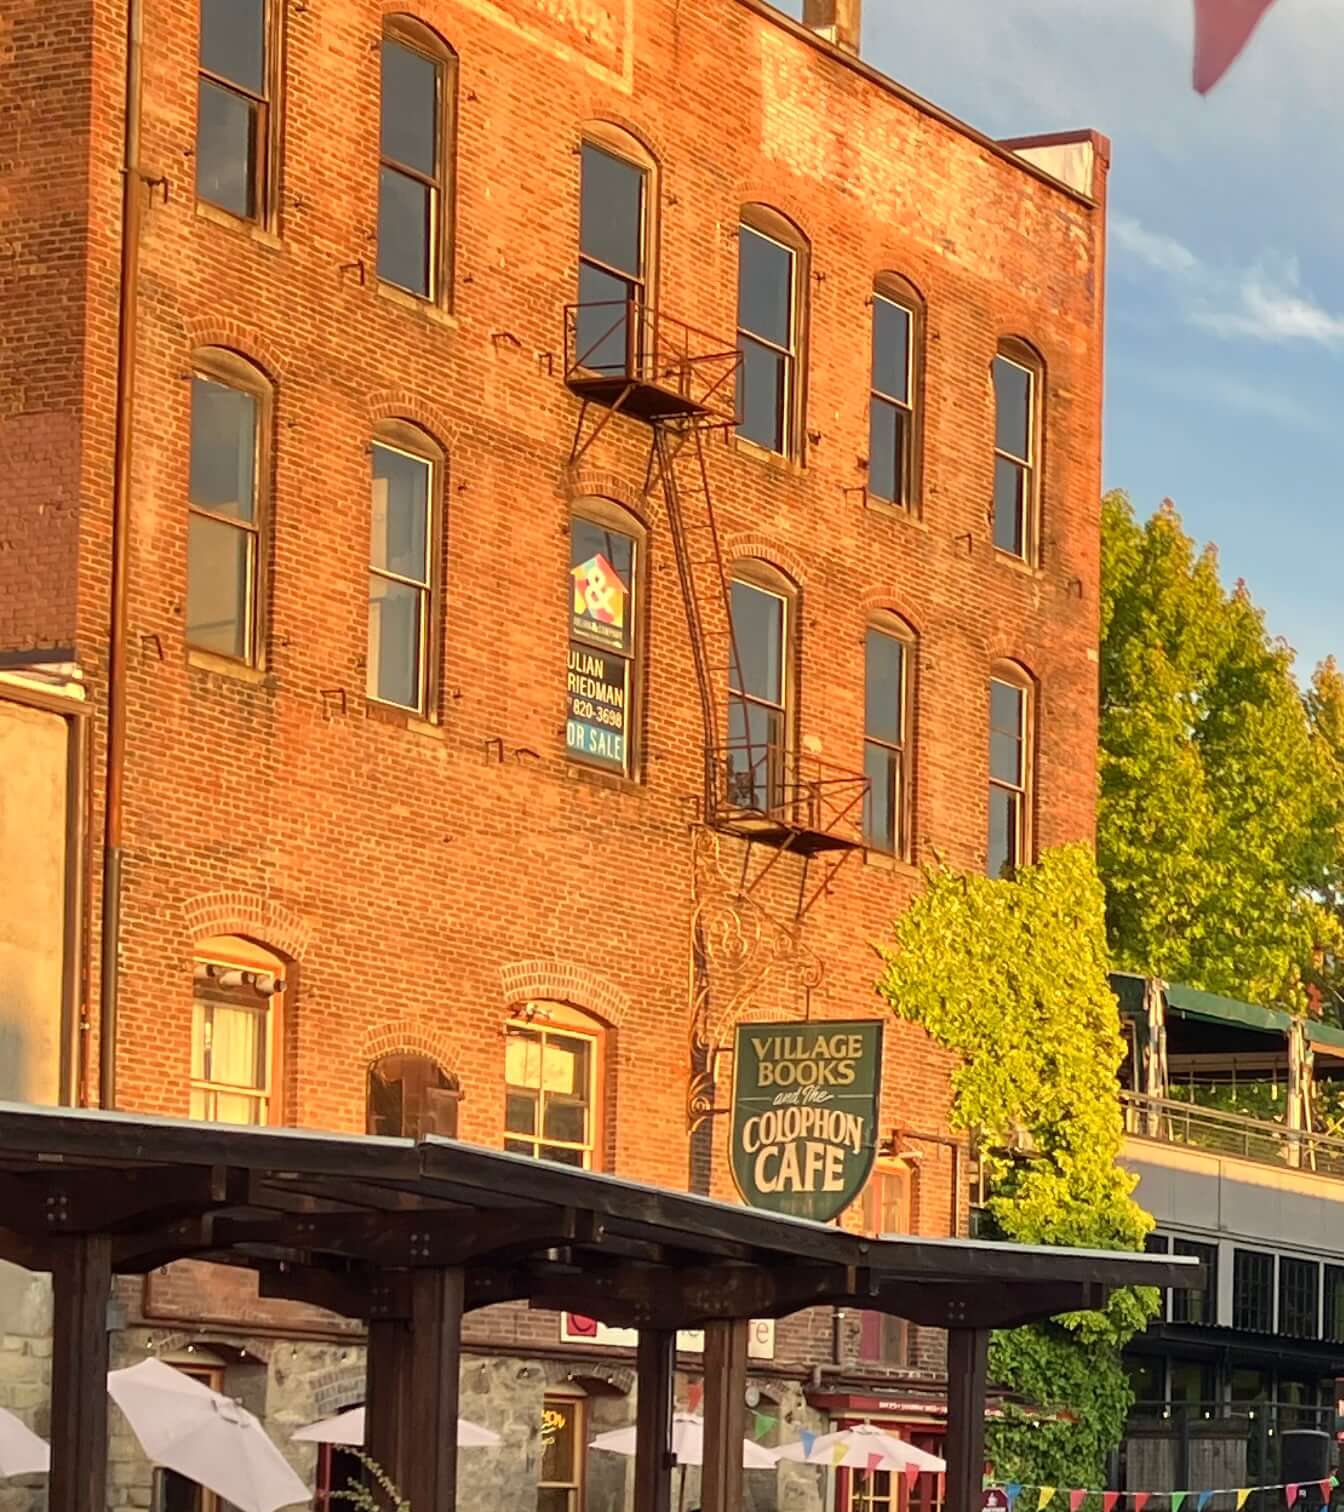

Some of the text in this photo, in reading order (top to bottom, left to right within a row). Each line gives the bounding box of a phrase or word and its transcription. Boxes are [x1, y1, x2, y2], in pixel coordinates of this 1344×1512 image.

[567, 651, 604, 679] ULIAN
[567, 671, 624, 708] RIEDMAN
[573, 698, 623, 729] 820-3698
[567, 722, 622, 761] OR SALE
[751, 1034, 864, 1060] VILLAGE
[757, 1059, 856, 1087] BOOKS
[772, 1086, 801, 1106] and
[742, 1106, 865, 1155] COLOPHON
[754, 1141, 846, 1193] CAFE
